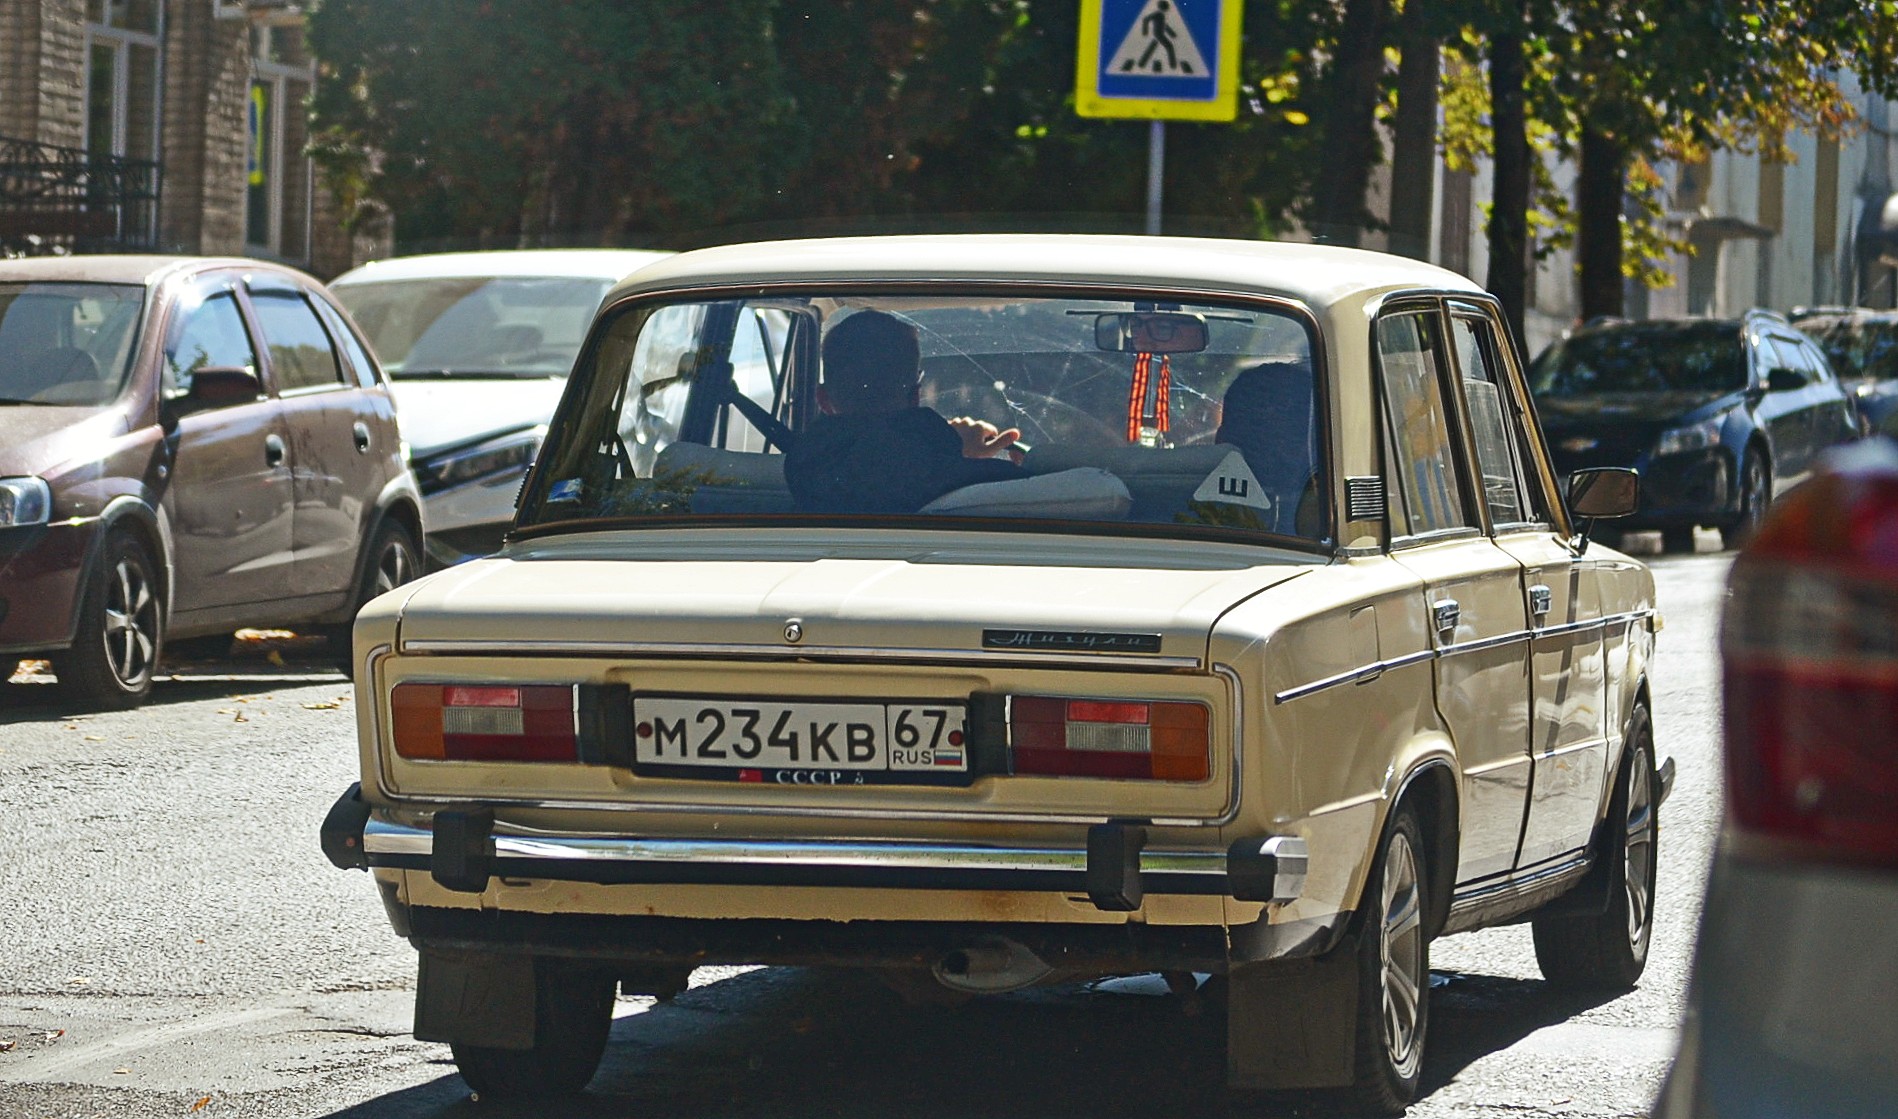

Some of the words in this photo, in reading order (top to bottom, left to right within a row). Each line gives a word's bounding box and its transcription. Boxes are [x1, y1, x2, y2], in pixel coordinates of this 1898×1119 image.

[1219, 477, 1248, 498] Ш
[895, 709, 947, 749] 67
[893, 750, 932, 765] RUS
[776, 770, 841, 785] СССР
